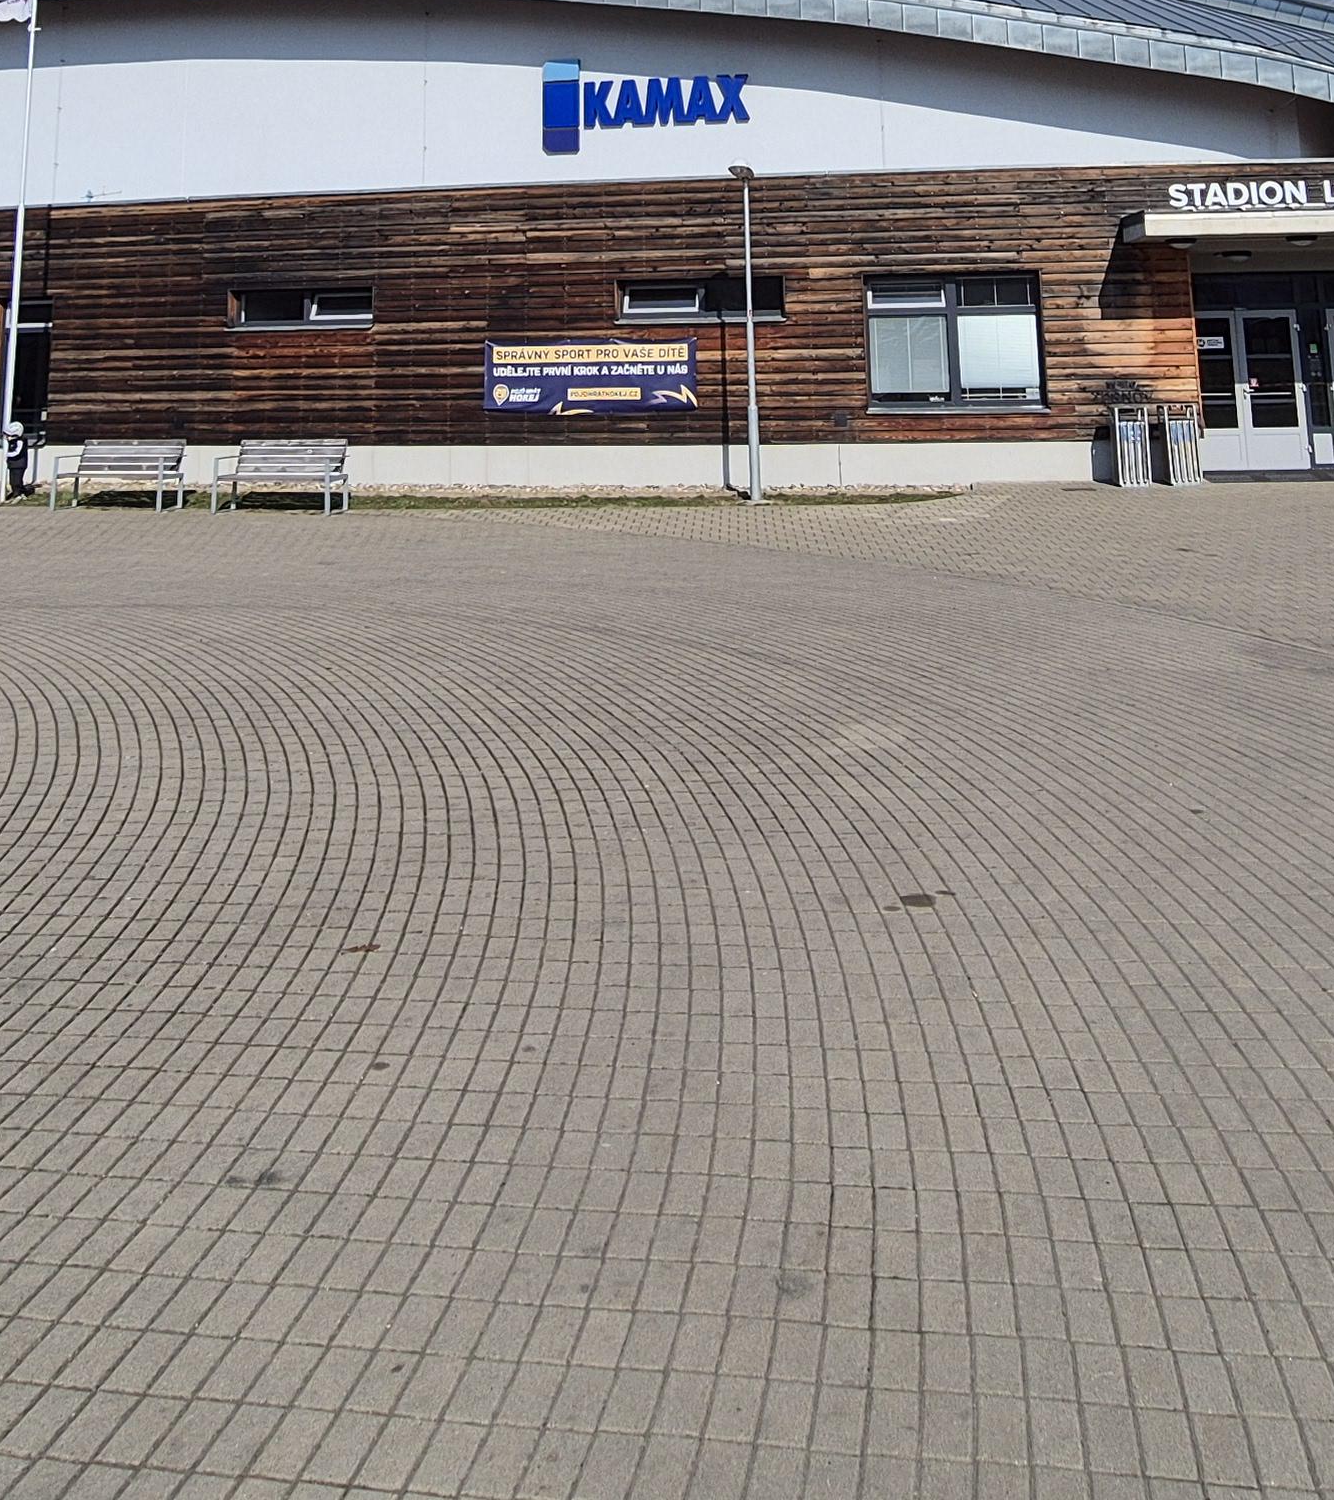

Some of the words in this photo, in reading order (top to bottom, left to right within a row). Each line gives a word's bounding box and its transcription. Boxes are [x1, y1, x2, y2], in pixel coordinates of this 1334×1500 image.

[584, 74, 751, 129] KAMAX
[1168, 180, 1308, 208] STADION
[496, 348, 549, 361] SPRÁVNÝ
[554, 348, 592, 359] SPORT
[596, 348, 619, 359] PRO
[624, 346, 655, 359] VAŠE
[658, 346, 685, 358] DÍTĚ
[493, 364, 541, 377] UDĚLEJTE
[542, 363, 571, 376] PRVNÍ
[573, 365, 600, 376] KROK
[601, 365, 609, 375] A
[610, 363, 655, 375] ZAČNĚTE
[657, 364, 665, 375] U
[667, 363, 688, 375] NÁS
